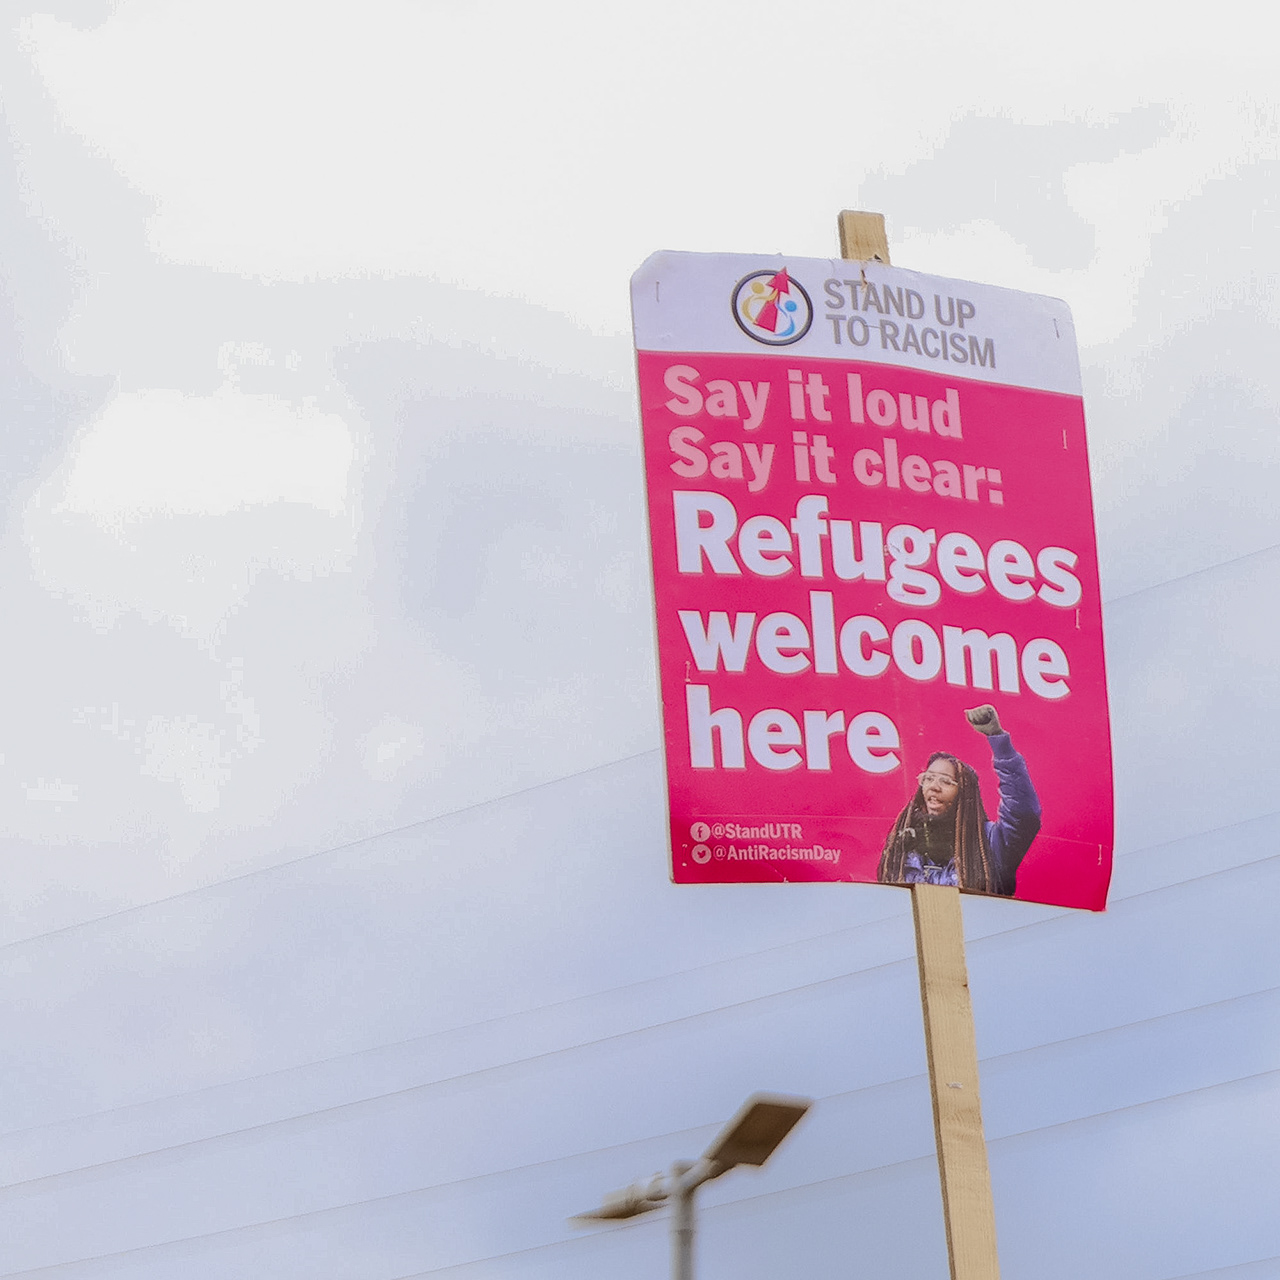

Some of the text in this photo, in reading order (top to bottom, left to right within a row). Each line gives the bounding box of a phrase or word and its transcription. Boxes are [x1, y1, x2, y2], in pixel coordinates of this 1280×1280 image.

[824, 279, 976, 329] STAND UP
[825, 313, 996, 368] TO RACISM
[663, 365, 964, 439] Say it loud
[668, 427, 1004, 505] Say it clear:
[672, 490, 1083, 608] Refugees
[678, 590, 1071, 700] welcome
[685, 684, 901, 774] here
[711, 822, 802, 839] @StandUTR
[713, 844, 841, 864] @AntiRacismDay
